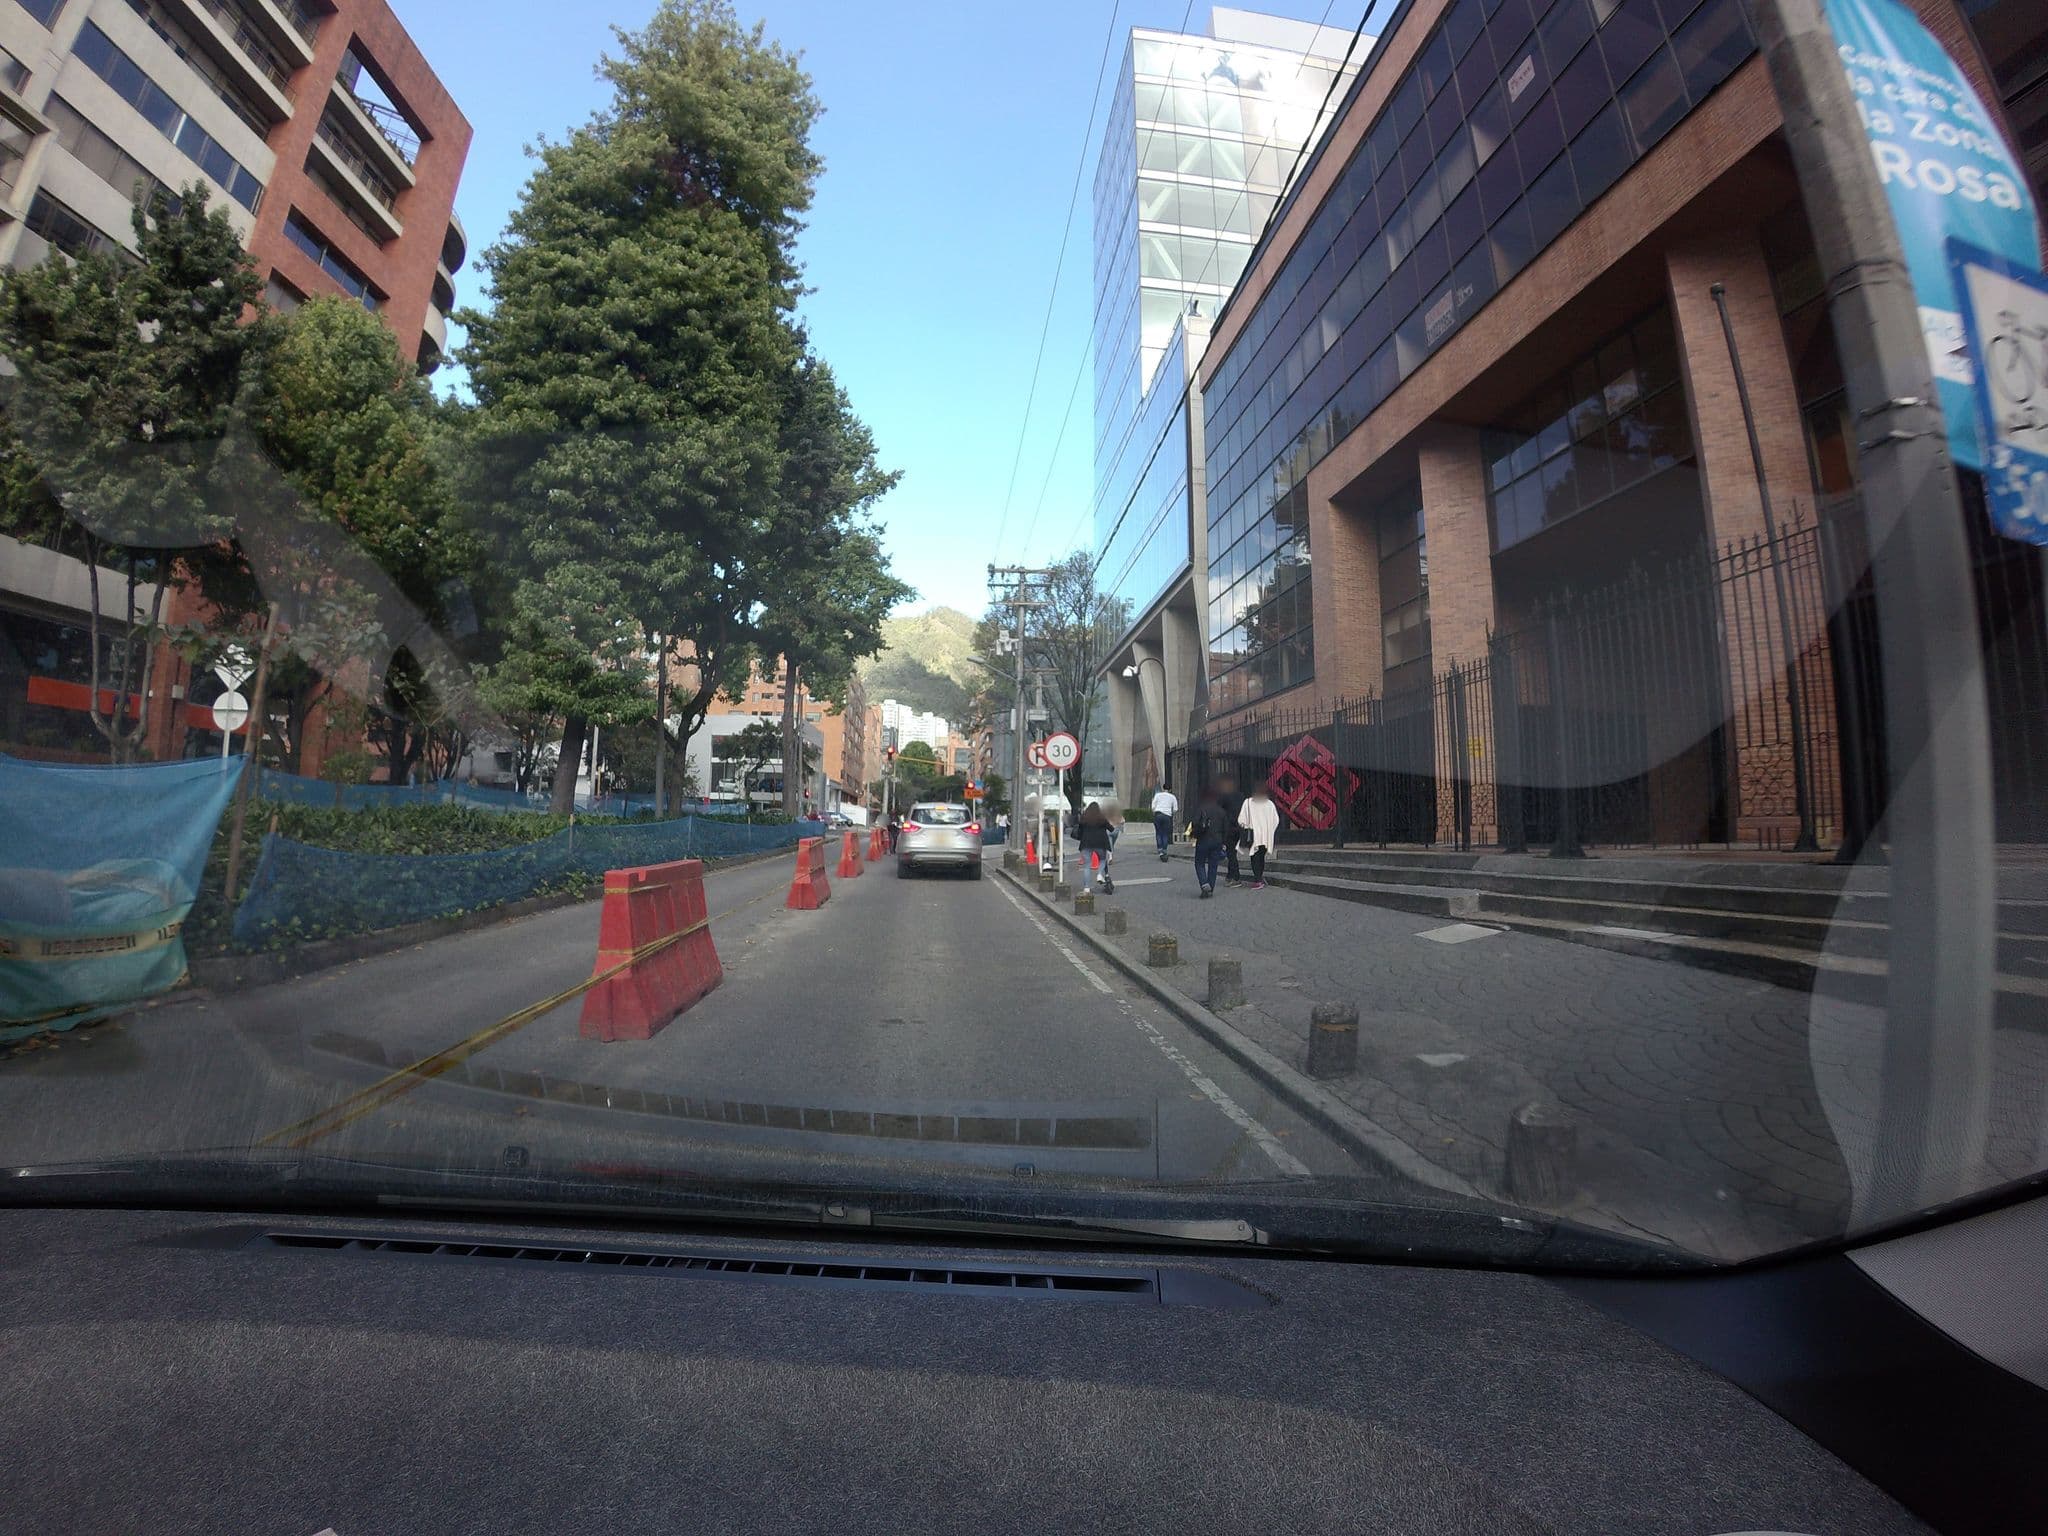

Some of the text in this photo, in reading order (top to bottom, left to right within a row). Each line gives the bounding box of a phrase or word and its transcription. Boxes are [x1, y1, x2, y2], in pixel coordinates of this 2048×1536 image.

[1855, 98, 1894, 135] la
[1903, 111, 2005, 162] Zona
[1869, 140, 2022, 211] Rosa
[1052, 744, 1072, 758] 30
